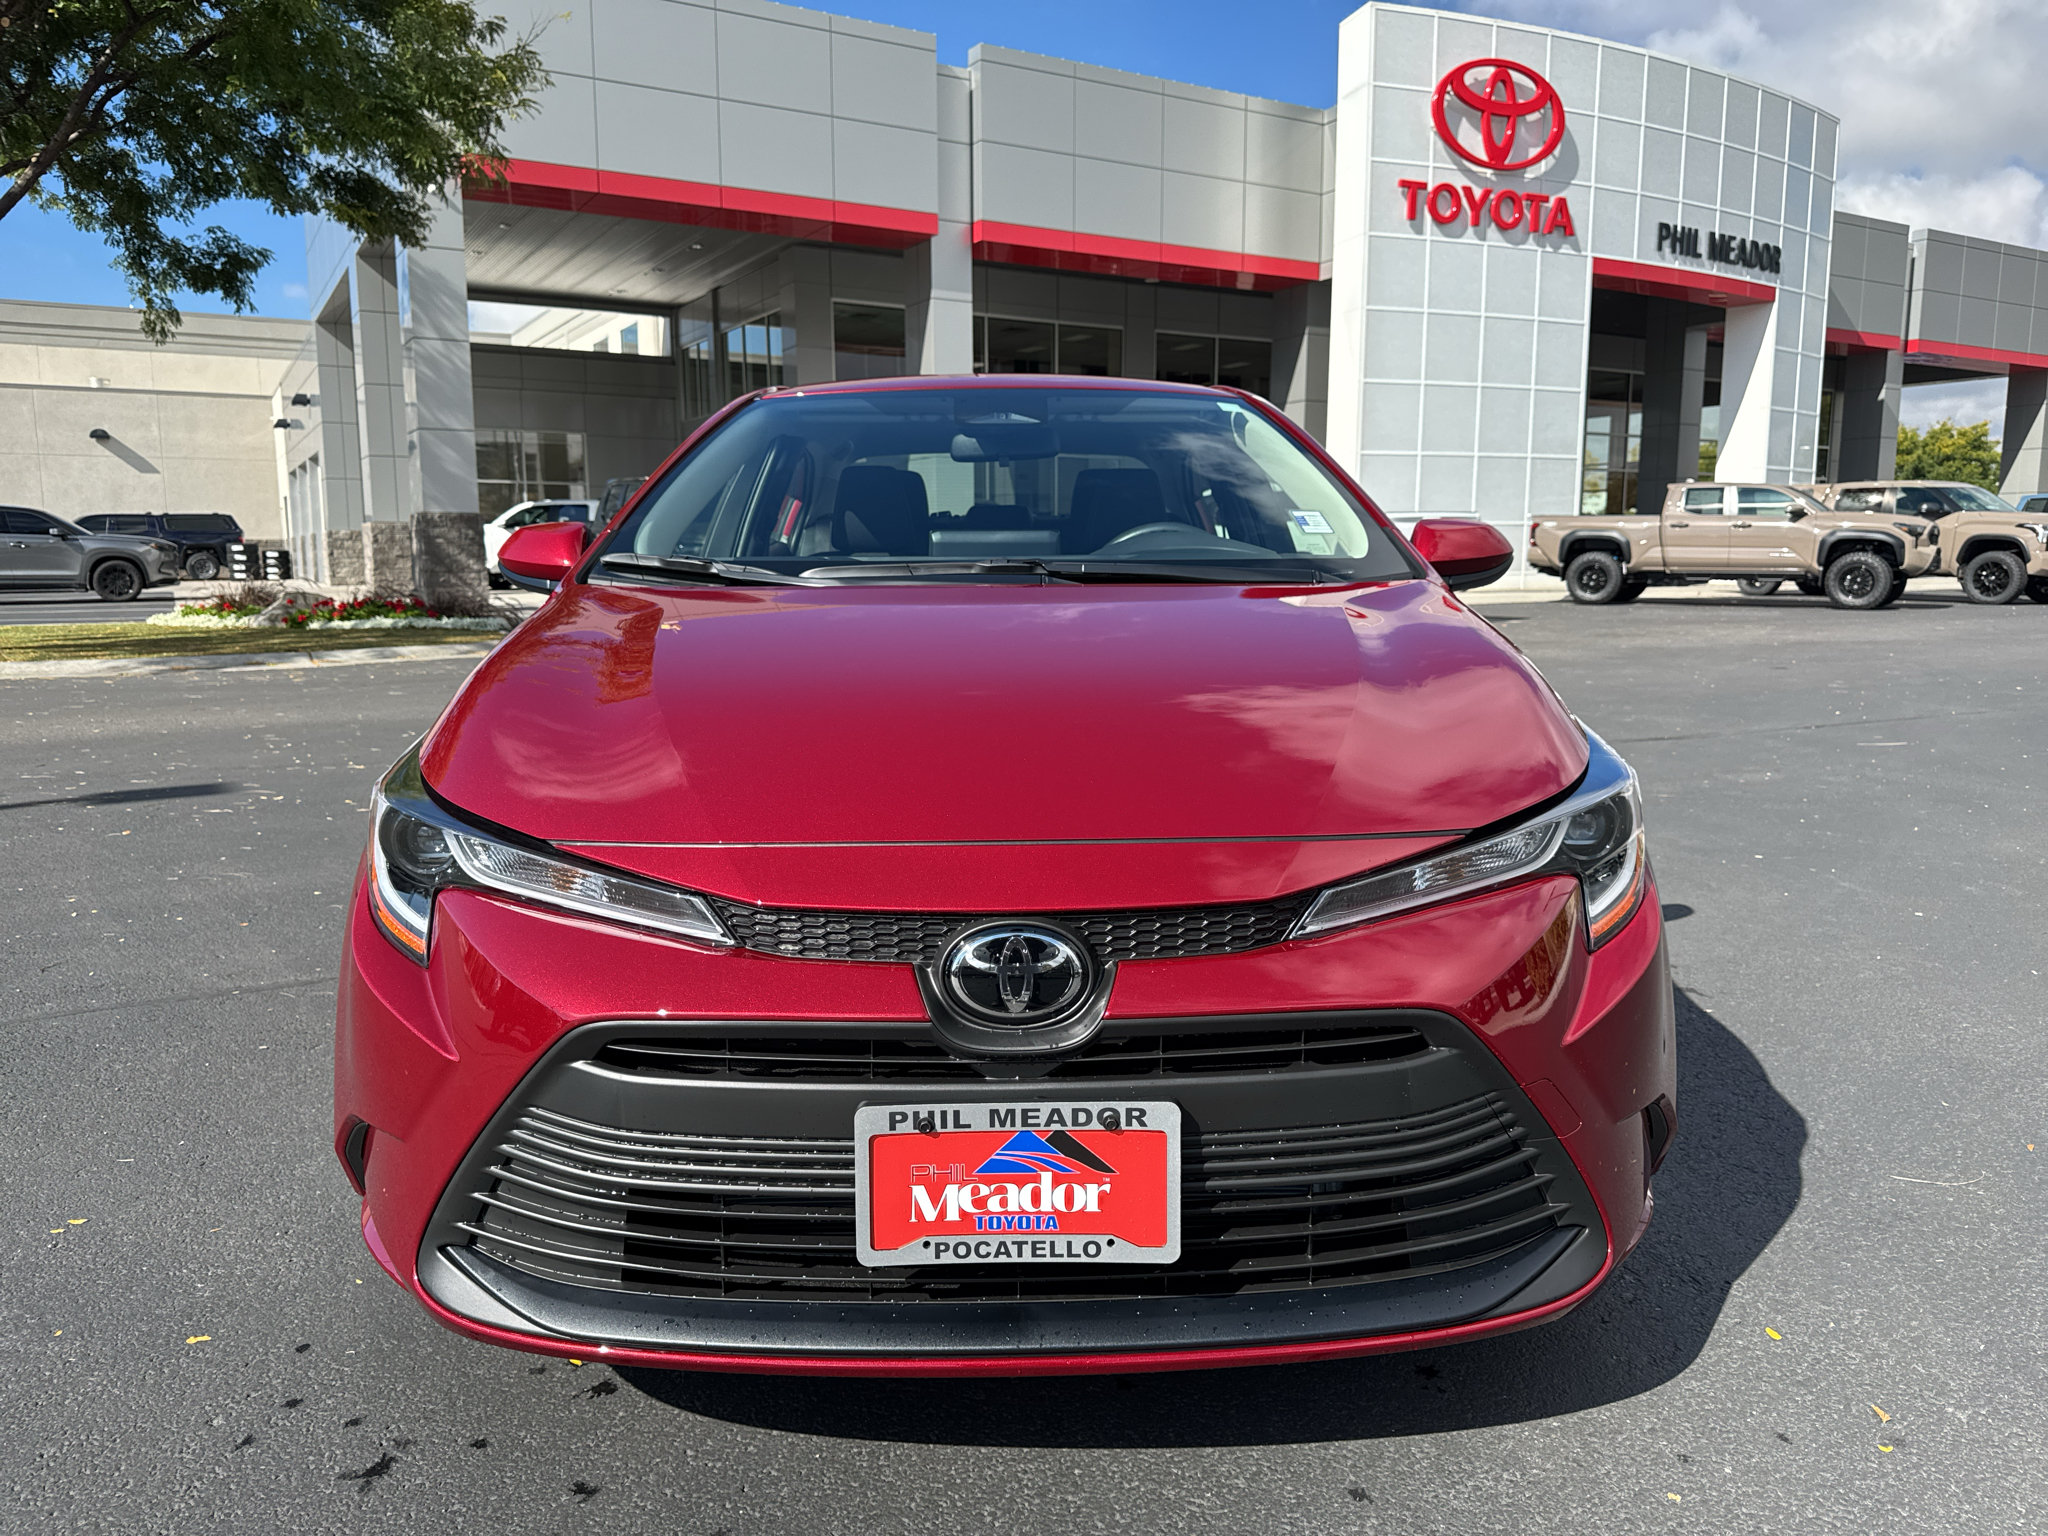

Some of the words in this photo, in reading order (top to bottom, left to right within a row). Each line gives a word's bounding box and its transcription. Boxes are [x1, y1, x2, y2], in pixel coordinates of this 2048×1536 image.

[1398, 178, 1575, 236] TOYOTA
[1657, 222, 1702, 258] PHIL
[1707, 231, 1782, 274] MEADOR
[888, 1109, 972, 1131] PHIL
[989, 1107, 1148, 1128] MEADOR
[910, 1163, 978, 1183] PHIL
[908, 1171, 1112, 1223] Meador
[973, 1214, 1060, 1231] TOYOTA
[934, 1240, 1102, 1260] POCATELLO
